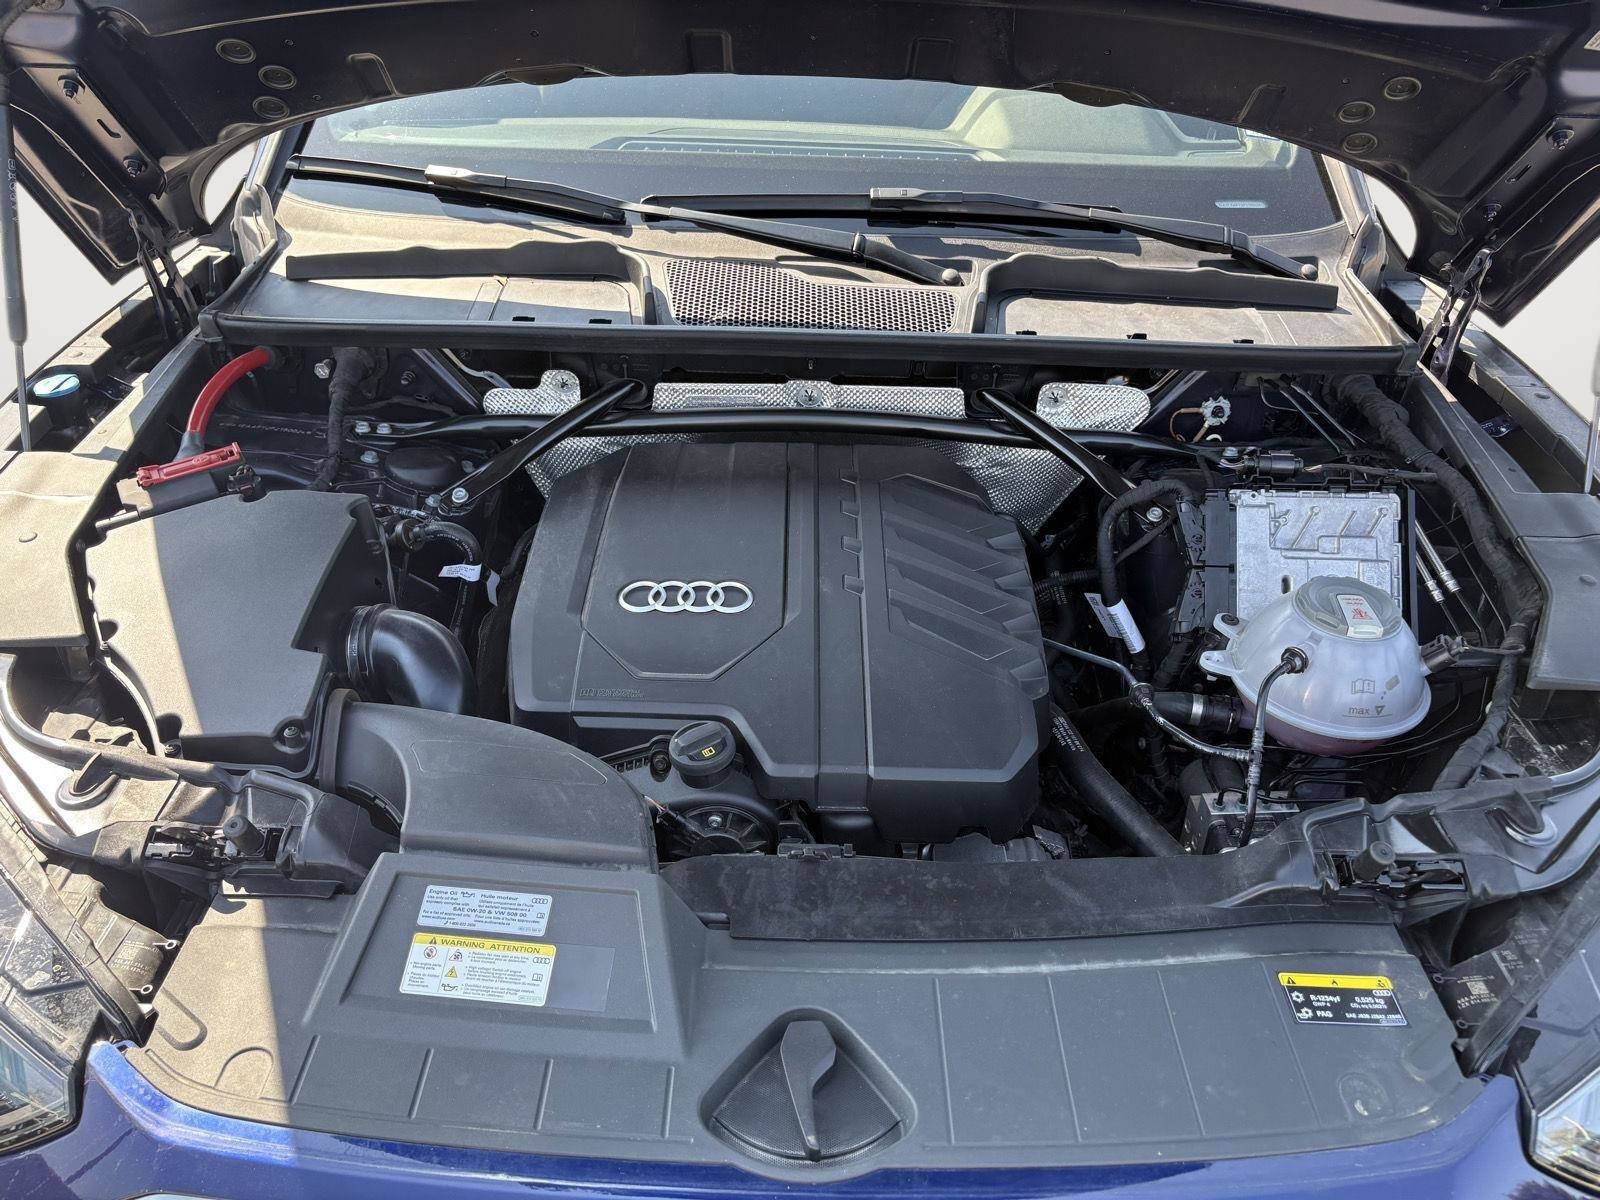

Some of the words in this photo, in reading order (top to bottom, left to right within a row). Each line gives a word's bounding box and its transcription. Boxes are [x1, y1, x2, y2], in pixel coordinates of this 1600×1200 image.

[1349, 707, 1370, 715] max
[441, 938, 485, 949] WARNING
[490, 943, 541, 954] ATTENTION
[1310, 994, 1340, 1003] R-1234yf
[1316, 1010, 1333, 1018] PAG
